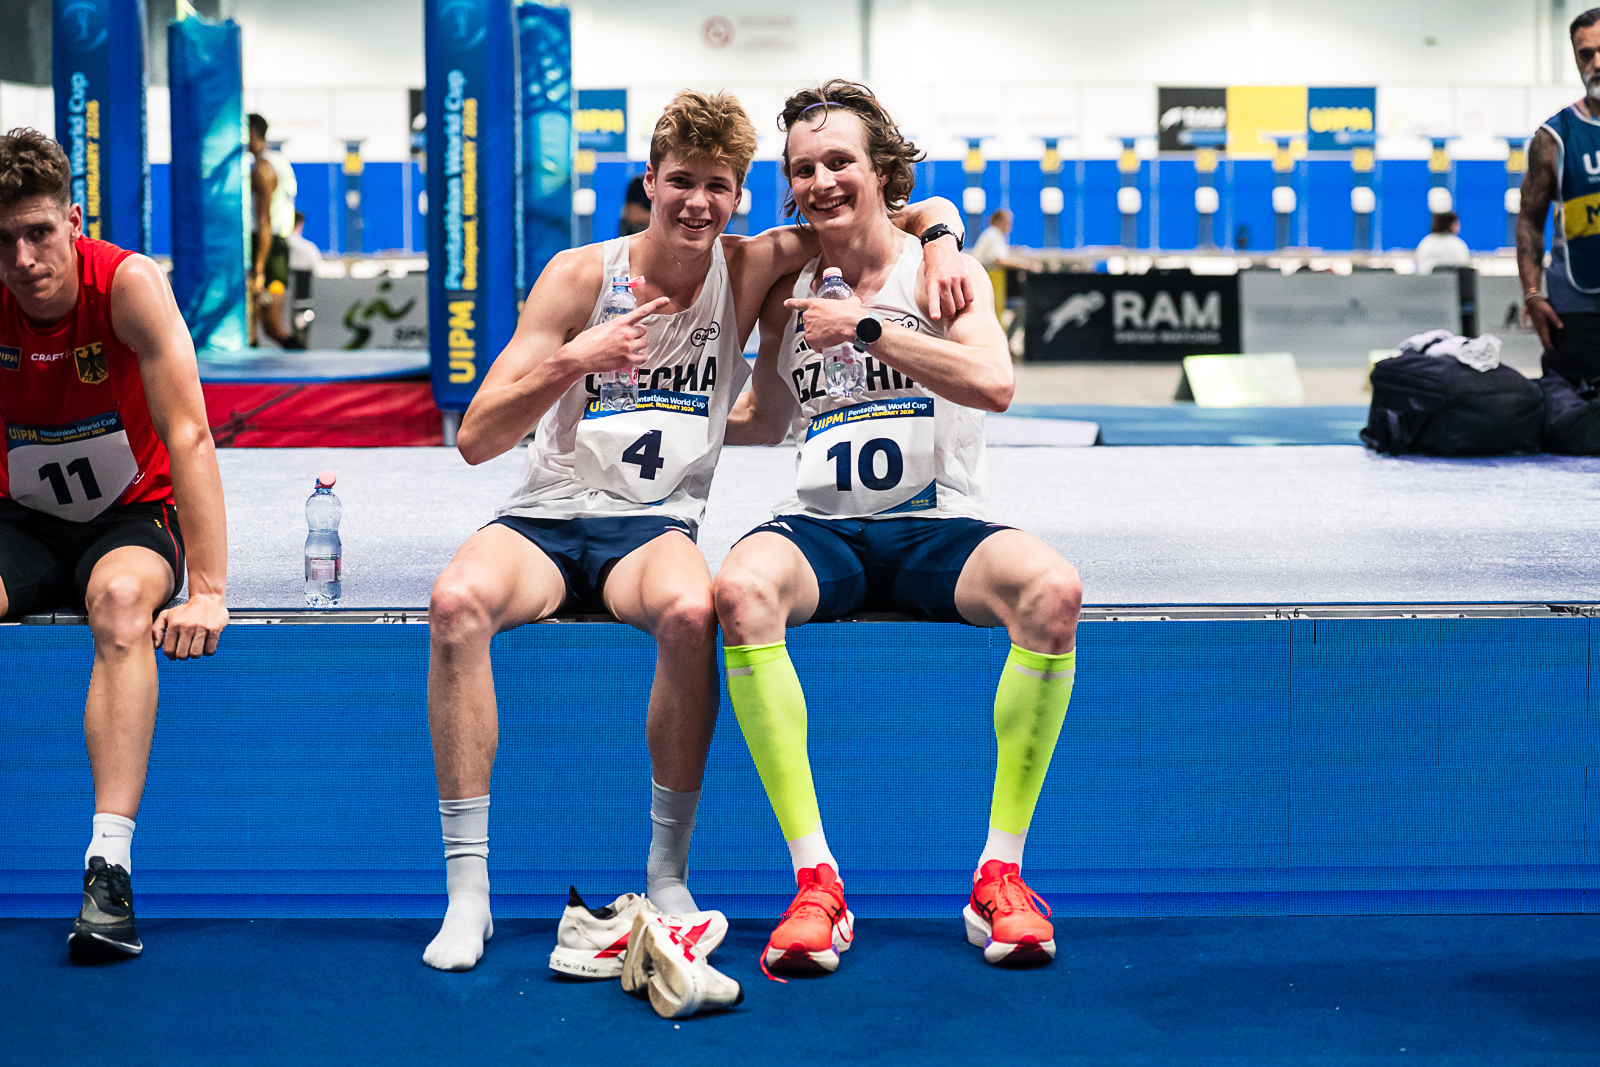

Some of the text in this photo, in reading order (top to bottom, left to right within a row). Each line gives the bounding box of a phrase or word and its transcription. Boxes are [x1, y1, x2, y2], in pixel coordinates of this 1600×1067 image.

[68, 72, 89, 113] Cup
[444, 69, 467, 112] Cup
[444, 113, 462, 176] World
[1112, 290, 1222, 330] RAM
[30, 352, 65, 361] CRAFT
[448, 301, 476, 383] UIPM
[670, 397, 690, 406] World
[692, 400, 706, 409] Cup
[812, 412, 844, 431] UIPM
[848, 402, 928, 416] Pentathlon World Cup
[9, 428, 38, 441] UIPM
[39, 418, 117, 438] Pentathlon World Cup
[91, 427, 106, 435] 2026
[621, 429, 664, 480] 4
[826, 437, 904, 491] 10
[37, 457, 103, 505] 11
